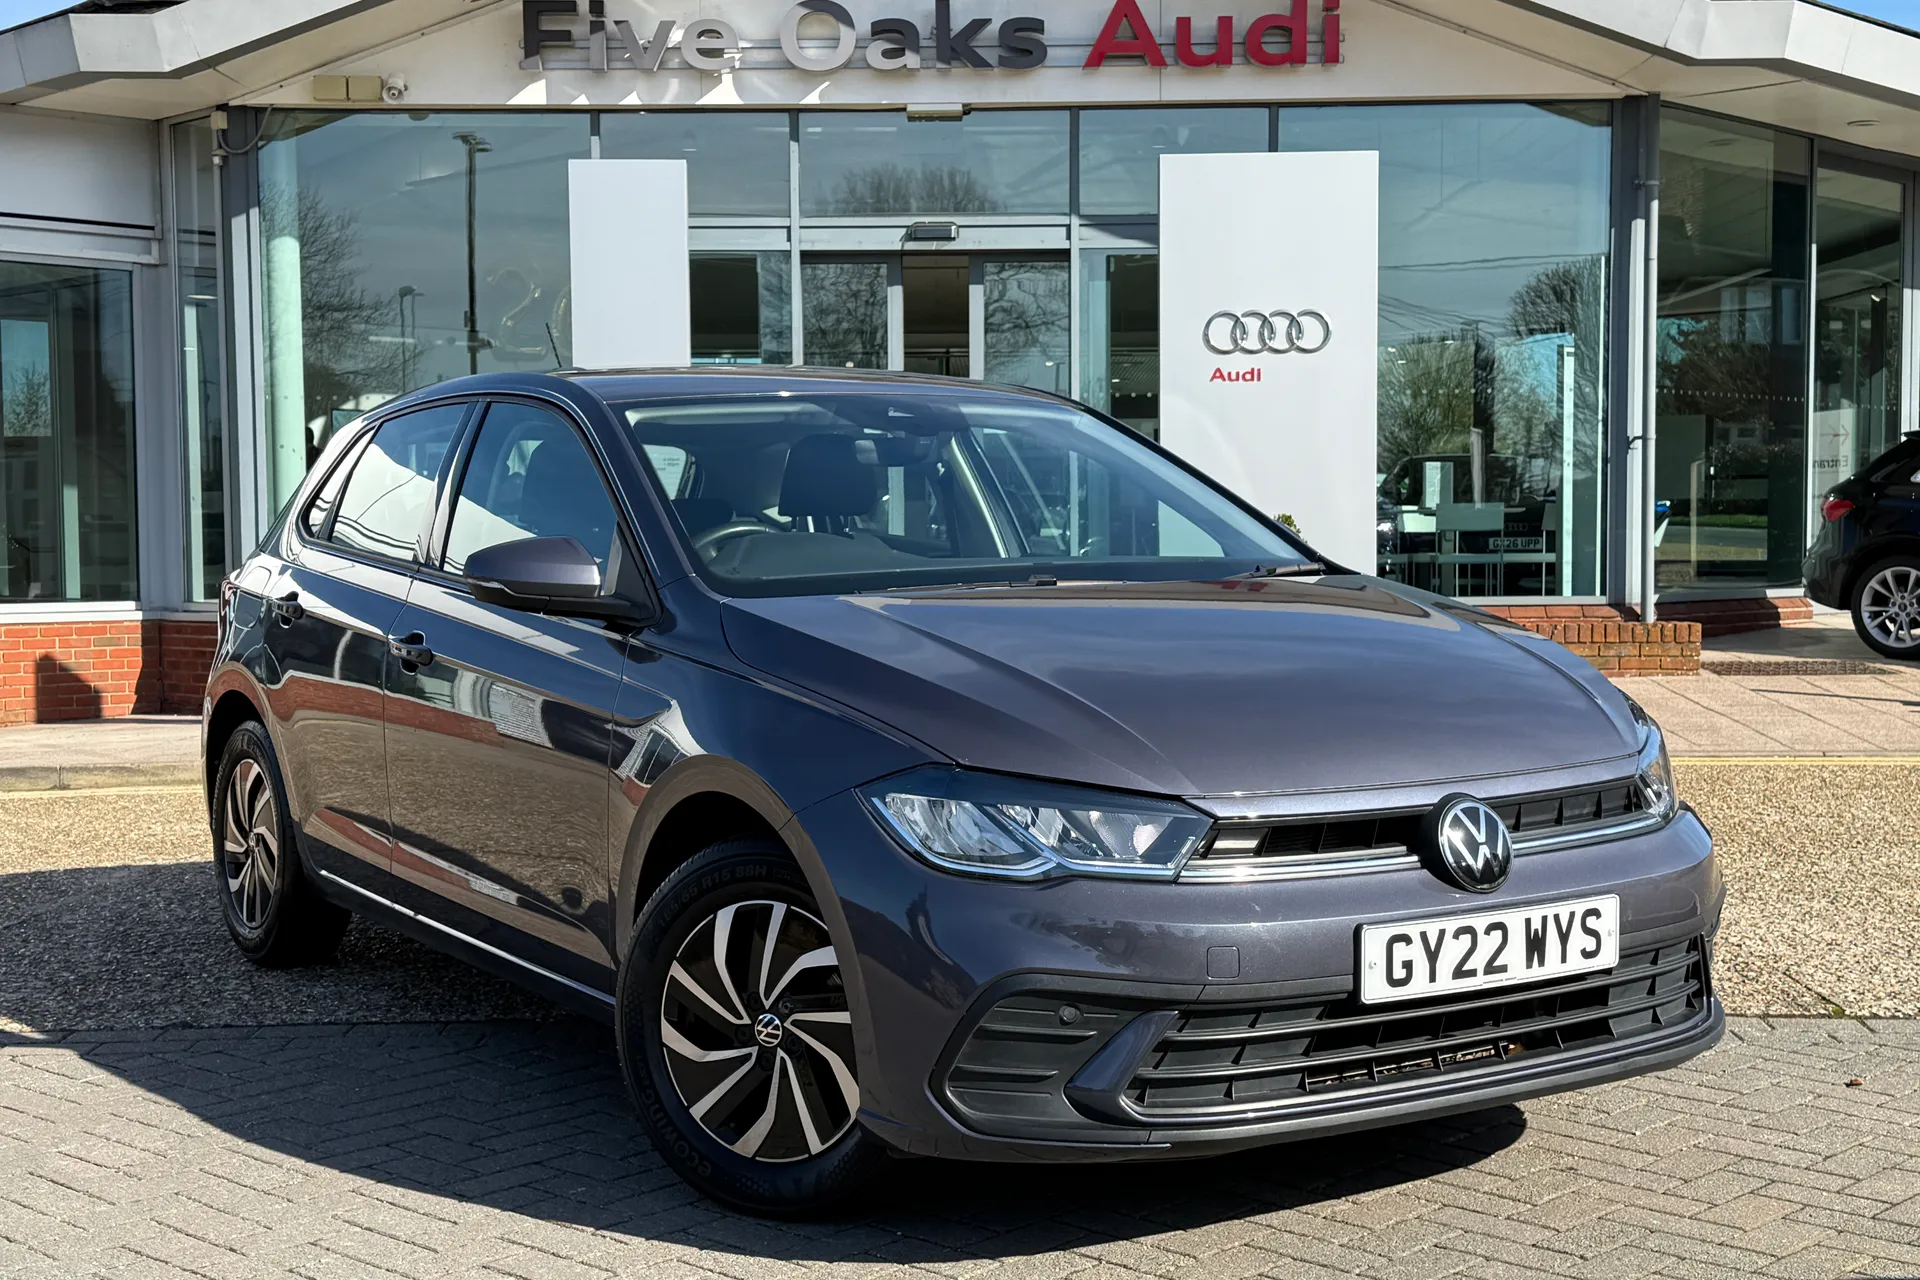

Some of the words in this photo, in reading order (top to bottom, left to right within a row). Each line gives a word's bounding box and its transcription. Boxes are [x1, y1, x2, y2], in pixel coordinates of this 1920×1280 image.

[527, 0, 741, 71] Five
[780, 0, 1048, 71] Oaks
[1082, 0, 1340, 69] Audi
[1209, 367, 1261, 382] Audi
[1520, 539, 1540, 549] UPP
[1385, 921, 1509, 988] GY22
[1524, 907, 1602, 970] WYS
